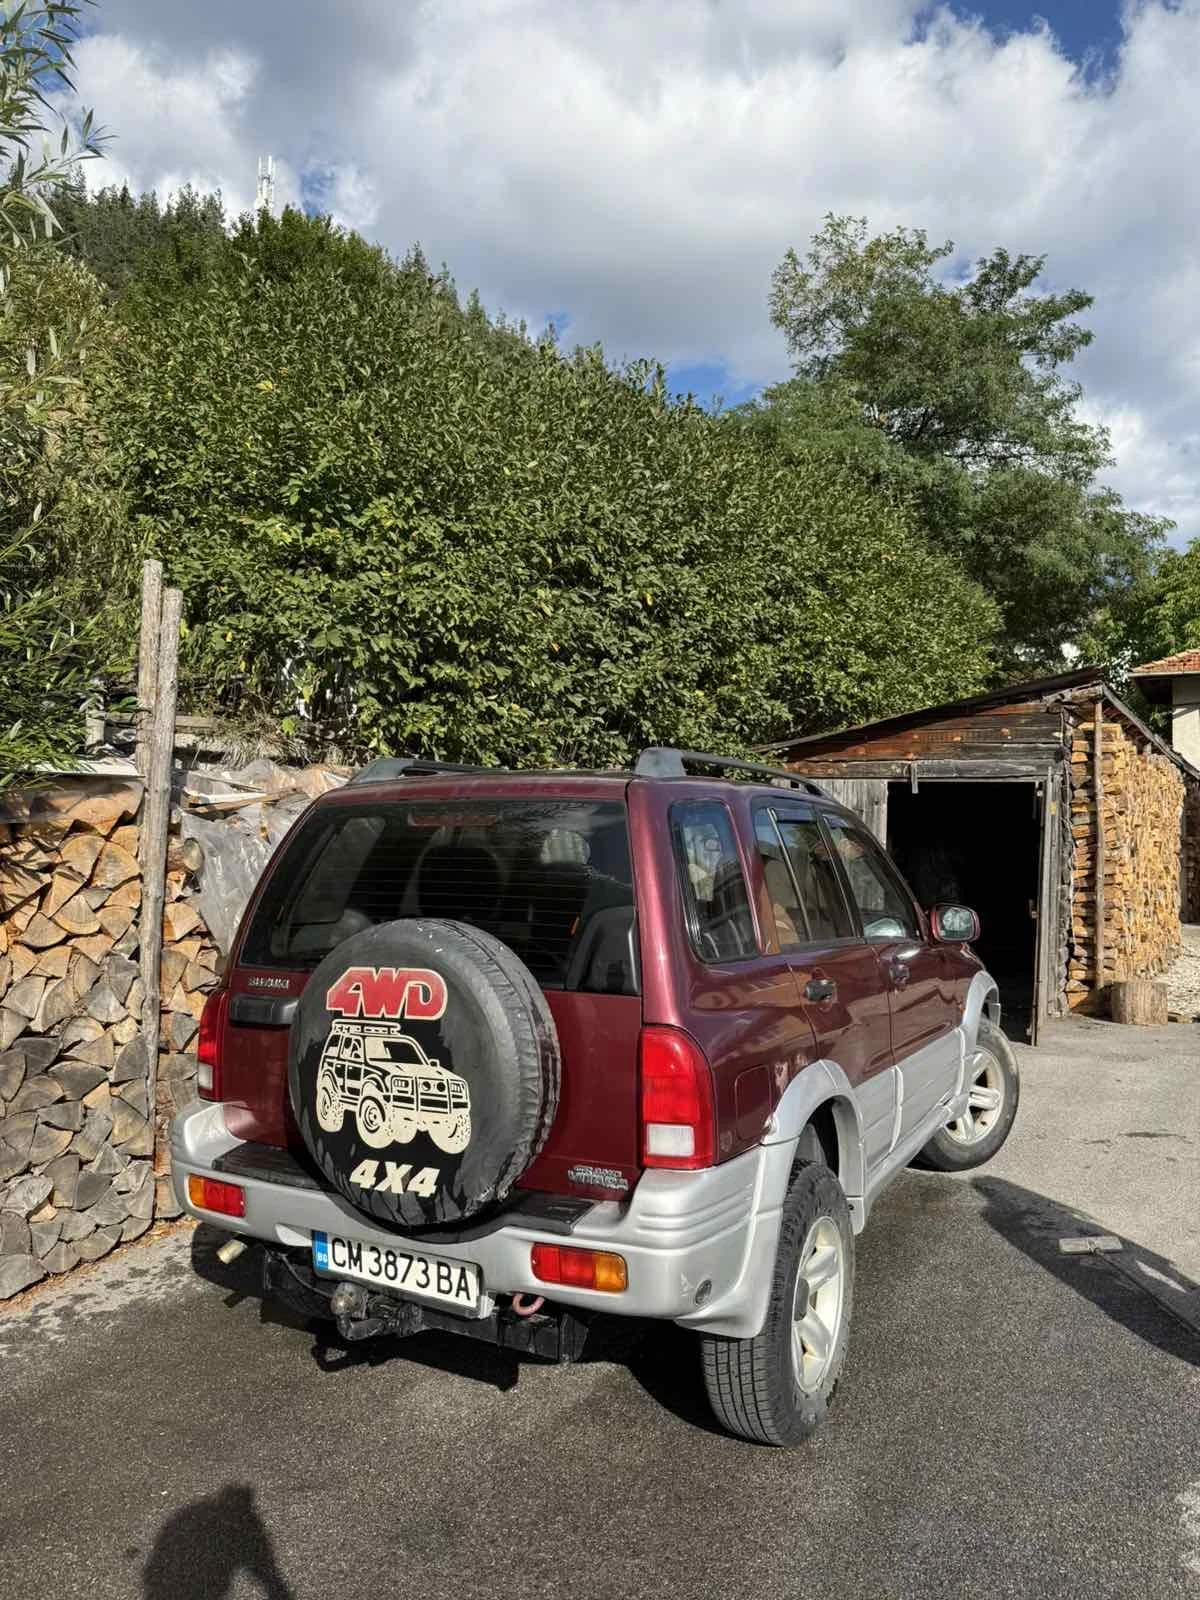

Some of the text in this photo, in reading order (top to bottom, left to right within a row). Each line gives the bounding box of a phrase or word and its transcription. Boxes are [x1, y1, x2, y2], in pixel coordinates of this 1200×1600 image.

[326, 967, 448, 1020] 4WD
[349, 1159, 440, 1197] 4X4
[331, 1237, 471, 1301] CM 3873 BA
